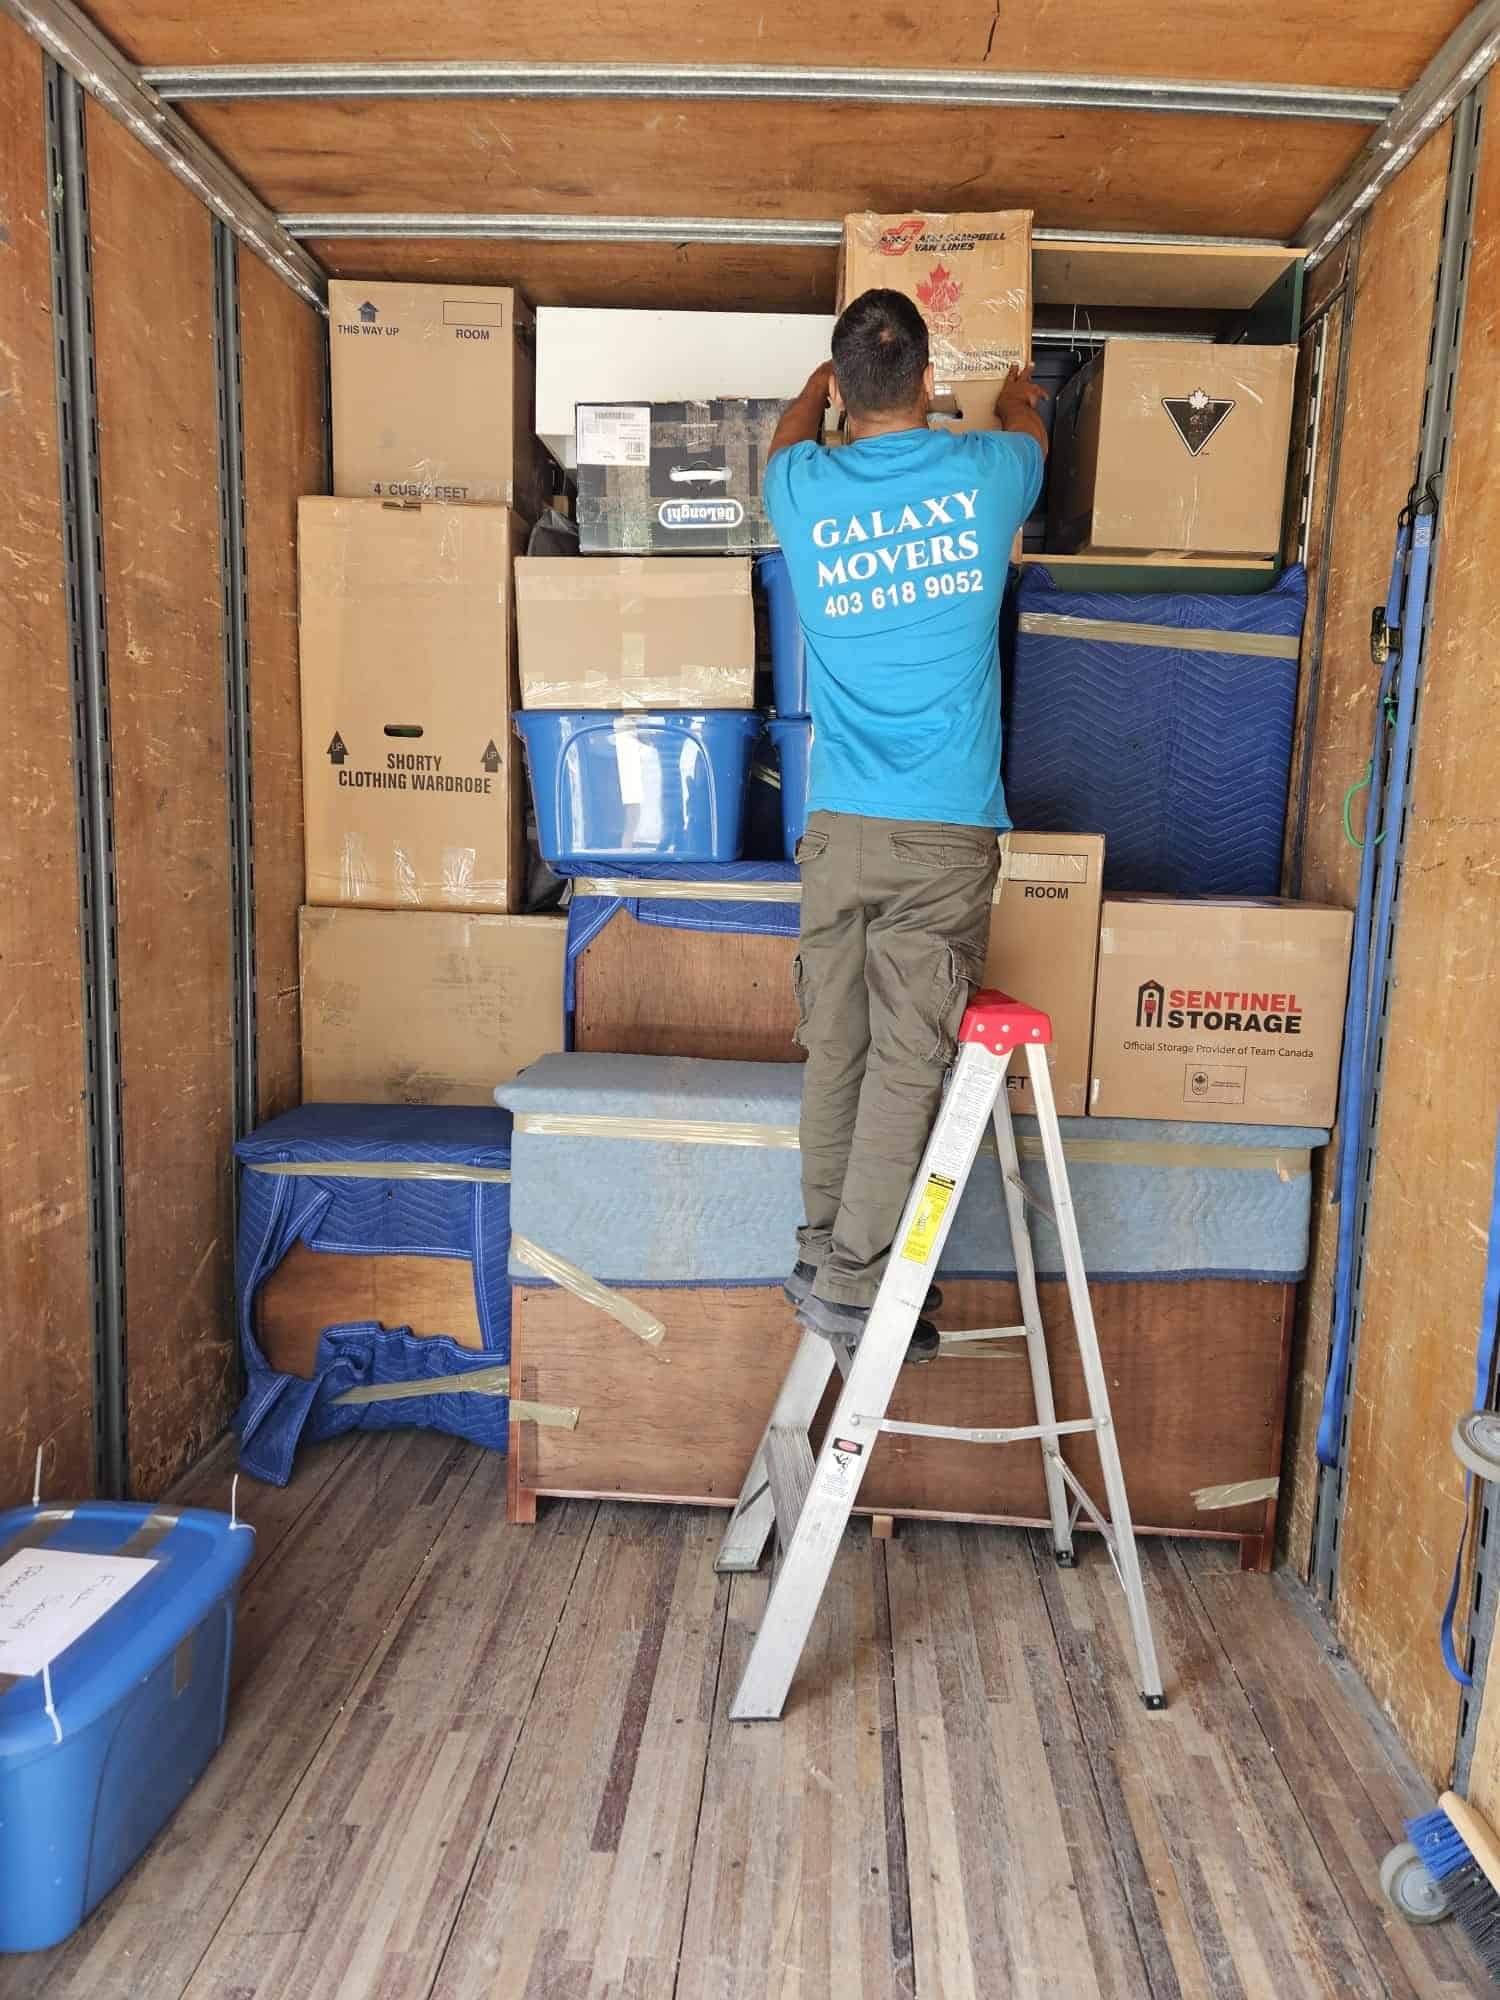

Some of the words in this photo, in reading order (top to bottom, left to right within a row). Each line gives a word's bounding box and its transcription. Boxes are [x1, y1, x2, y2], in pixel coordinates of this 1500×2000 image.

[944, 232, 1007, 242] CAMPBELL
[914, 243, 937, 252] VAN
[941, 242, 975, 252] LINES
[337, 325, 360, 335] THIS
[362, 326, 383, 336] WAY
[386, 327, 400, 336] UP
[455, 328, 490, 341] ROOM
[373, 482, 382, 495] 4
[434, 486, 470, 499] FEET
[812, 488, 979, 548] GALAXY
[817, 530, 979, 588] MOVERS
[825, 591, 864, 618] 403
[871, 581, 916, 610] 618
[924, 570, 984, 599] 9052
[331, 743, 344, 752] UP
[486, 751, 498, 760] UP
[387, 753, 442, 772] SHORTY
[338, 770, 407, 790] CLOTHING
[411, 774, 492, 794] WARDROBE
[1024, 886, 1069, 899] ROOM
[1168, 989, 1303, 1014] SENTINEL
[1167, 1010, 1302, 1035] STORAGE
[1123, 1041, 1155, 1052] Official
[1157, 1042, 1194, 1055] Storage
[1196, 1044, 1236, 1056] Provider
[1238, 1046, 1249, 1056] of
[1251, 1046, 1276, 1057] Team
[1278, 1047, 1315, 1059] Canada
